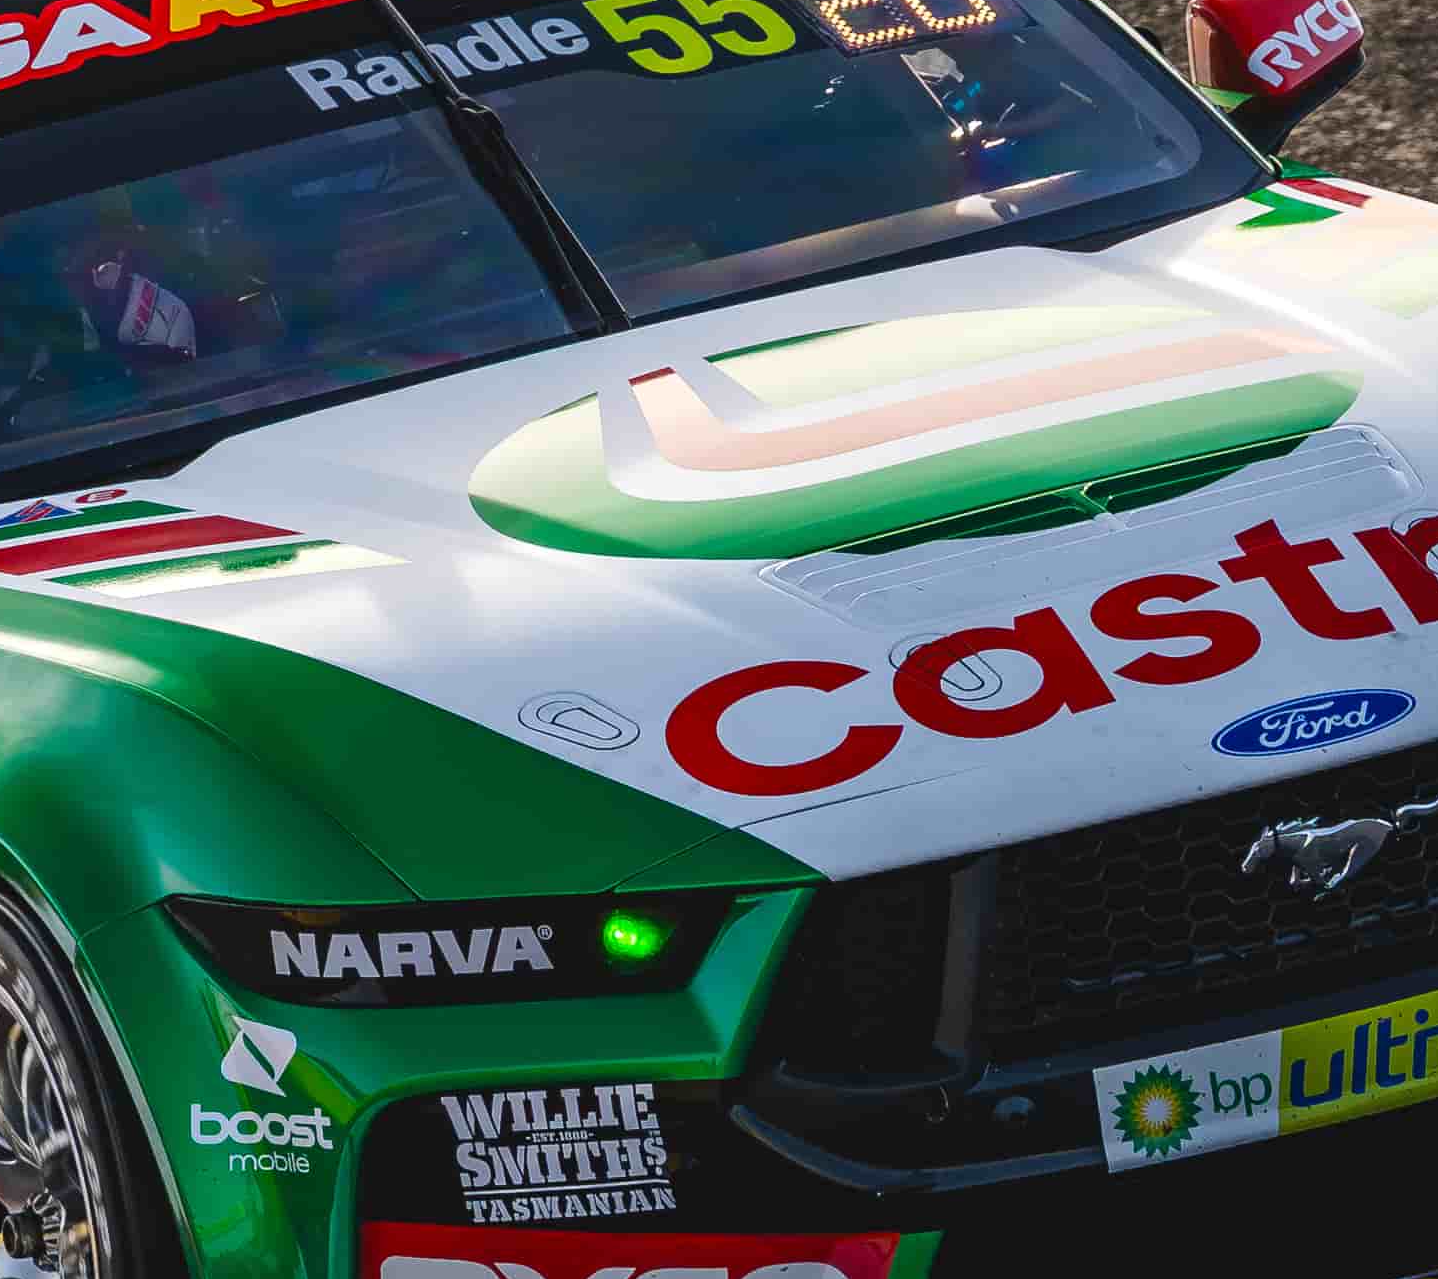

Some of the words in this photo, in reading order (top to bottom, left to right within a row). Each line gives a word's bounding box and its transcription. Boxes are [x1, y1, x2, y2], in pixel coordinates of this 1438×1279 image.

[285, 16, 590, 111] Randle
[1259, 700, 1377, 748] Ford
[440, 1083, 660, 1141] WILLIE
[1209, 1069, 1272, 1117] bp
[190, 1103, 334, 1150] boost
[229, 1152, 310, 1174] mobile
[466, 1187, 677, 1223] TASMANIAN
